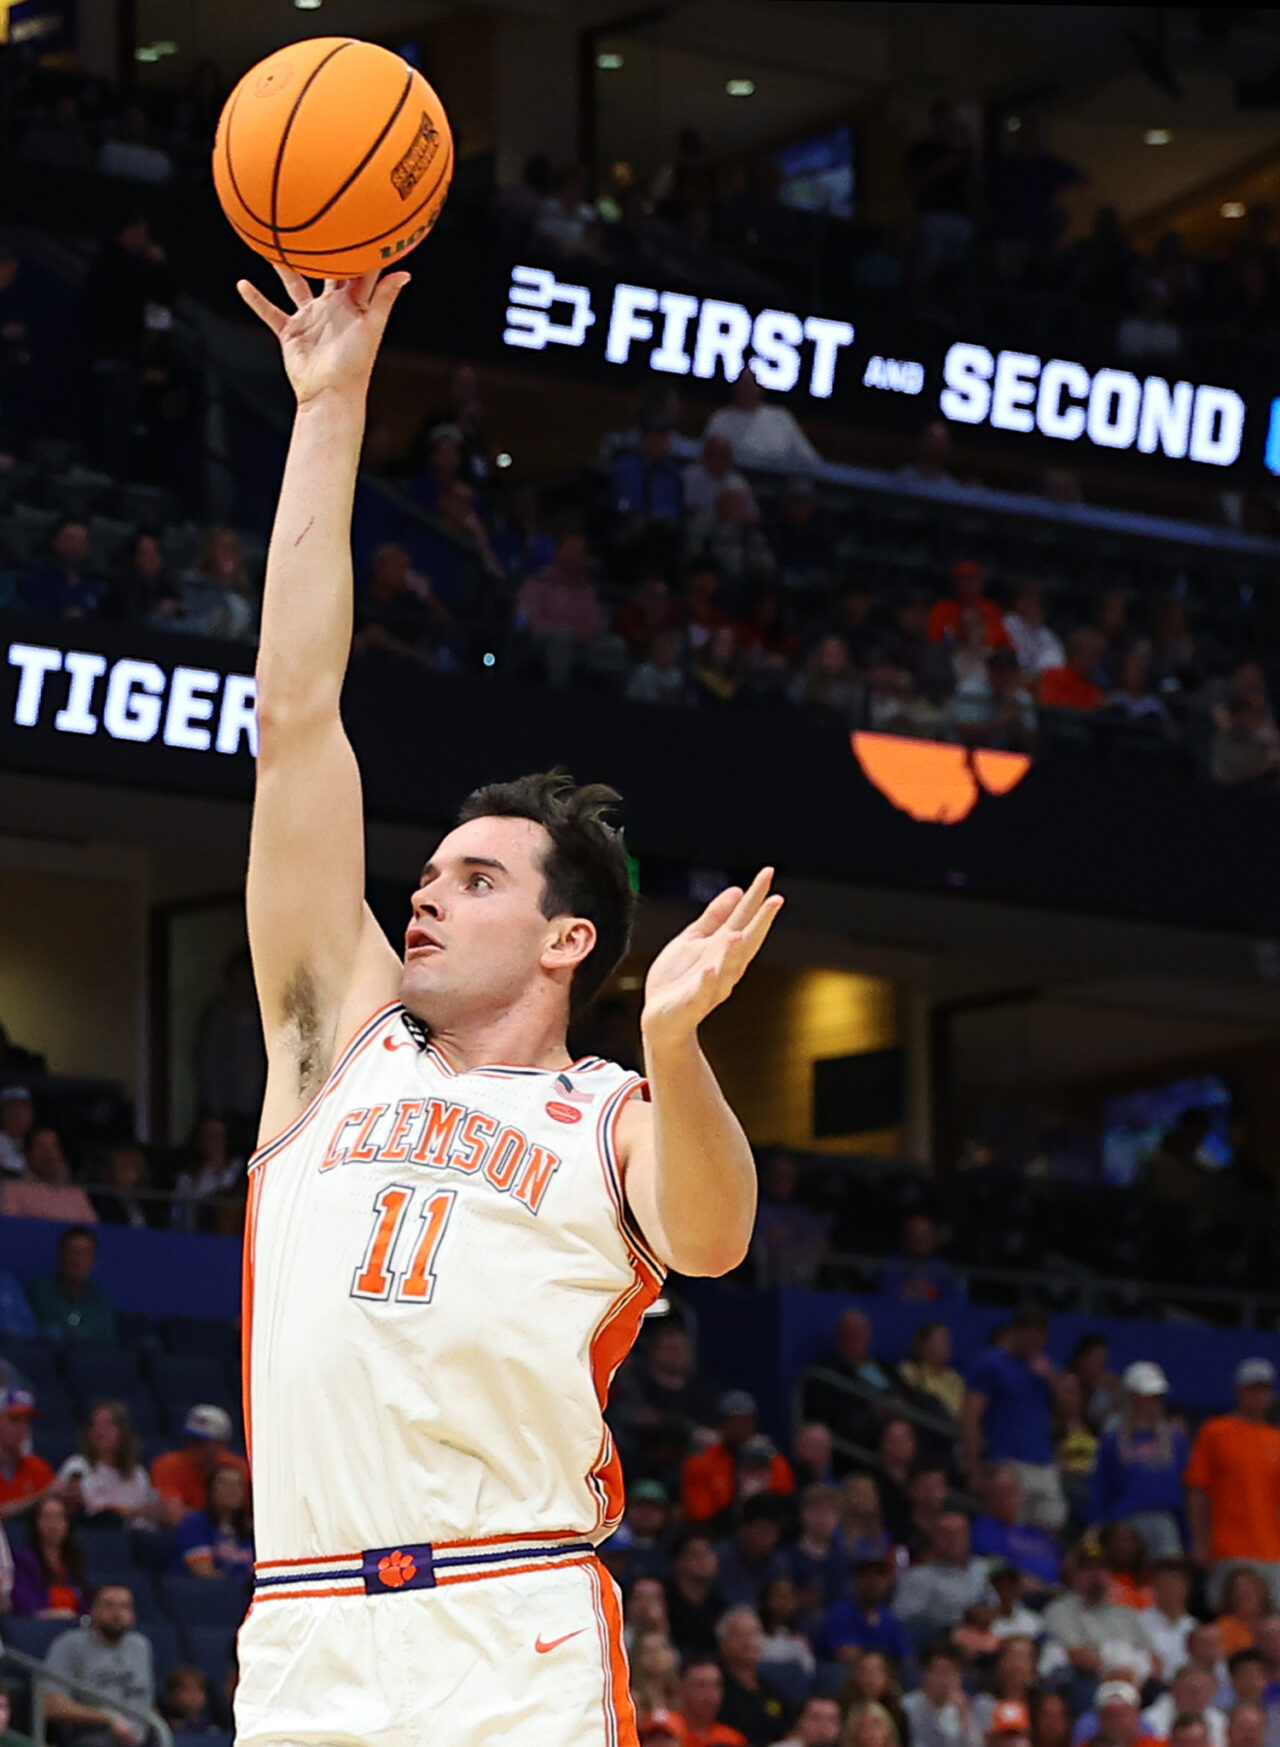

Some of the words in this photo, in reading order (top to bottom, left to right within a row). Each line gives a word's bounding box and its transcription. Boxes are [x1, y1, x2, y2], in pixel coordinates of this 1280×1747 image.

[605, 283, 855, 399] FIRST
[863, 355, 925, 395] AND
[939, 342, 1245, 466] SECOND
[319, 1097, 562, 1216] CLEMSON
[349, 1183, 458, 1304] 11
